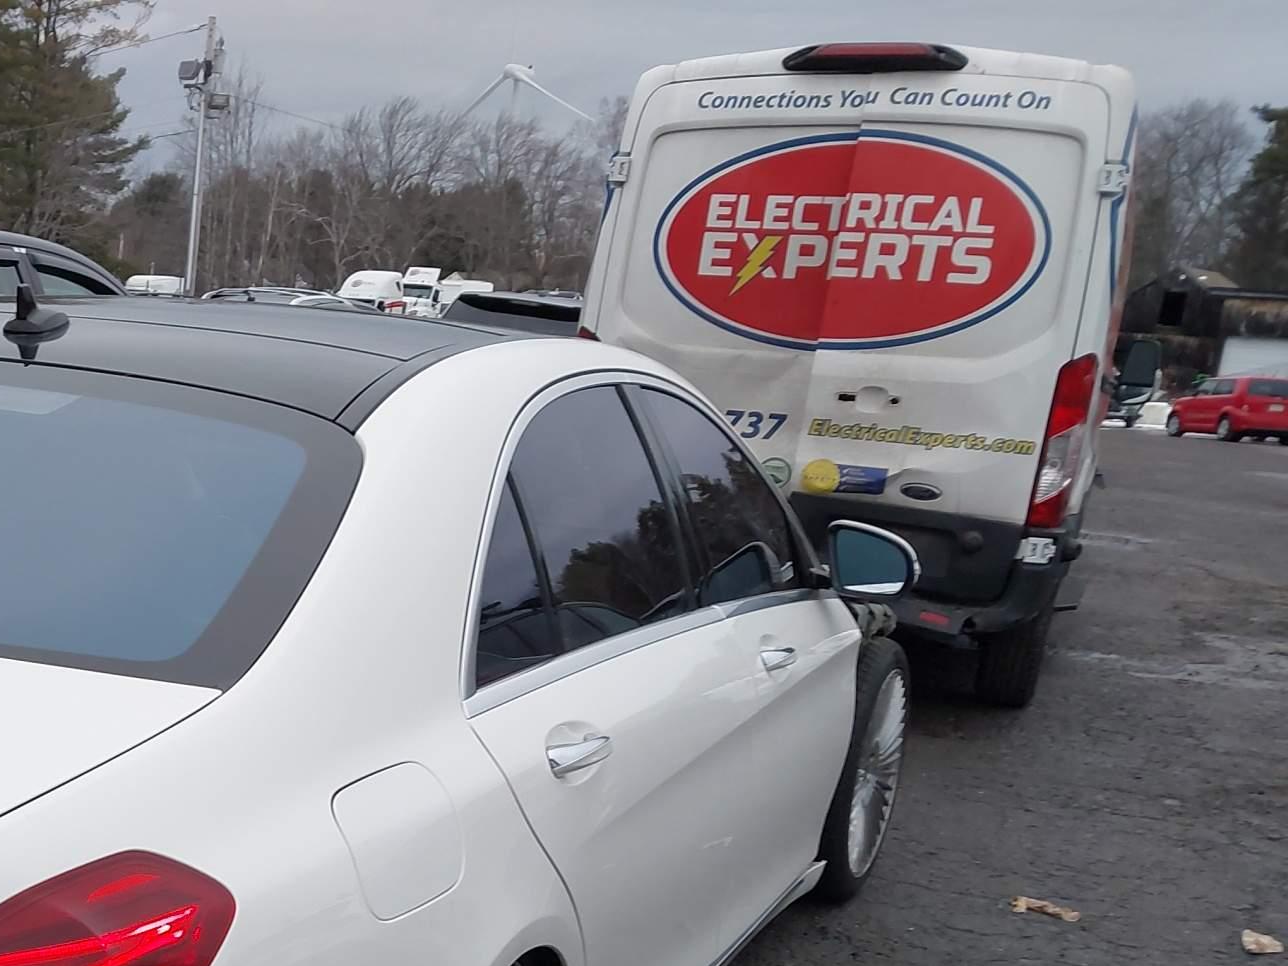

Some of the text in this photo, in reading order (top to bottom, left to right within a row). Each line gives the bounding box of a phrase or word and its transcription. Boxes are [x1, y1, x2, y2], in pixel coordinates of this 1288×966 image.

[697, 87, 1052, 110] Connections You Can Count On
[705, 192, 995, 234] ELECTRICAL
[697, 231, 995, 285] EXPERTS
[725, 409, 788, 440] 737
[807, 417, 1037, 456] ElectricalExperts.com
